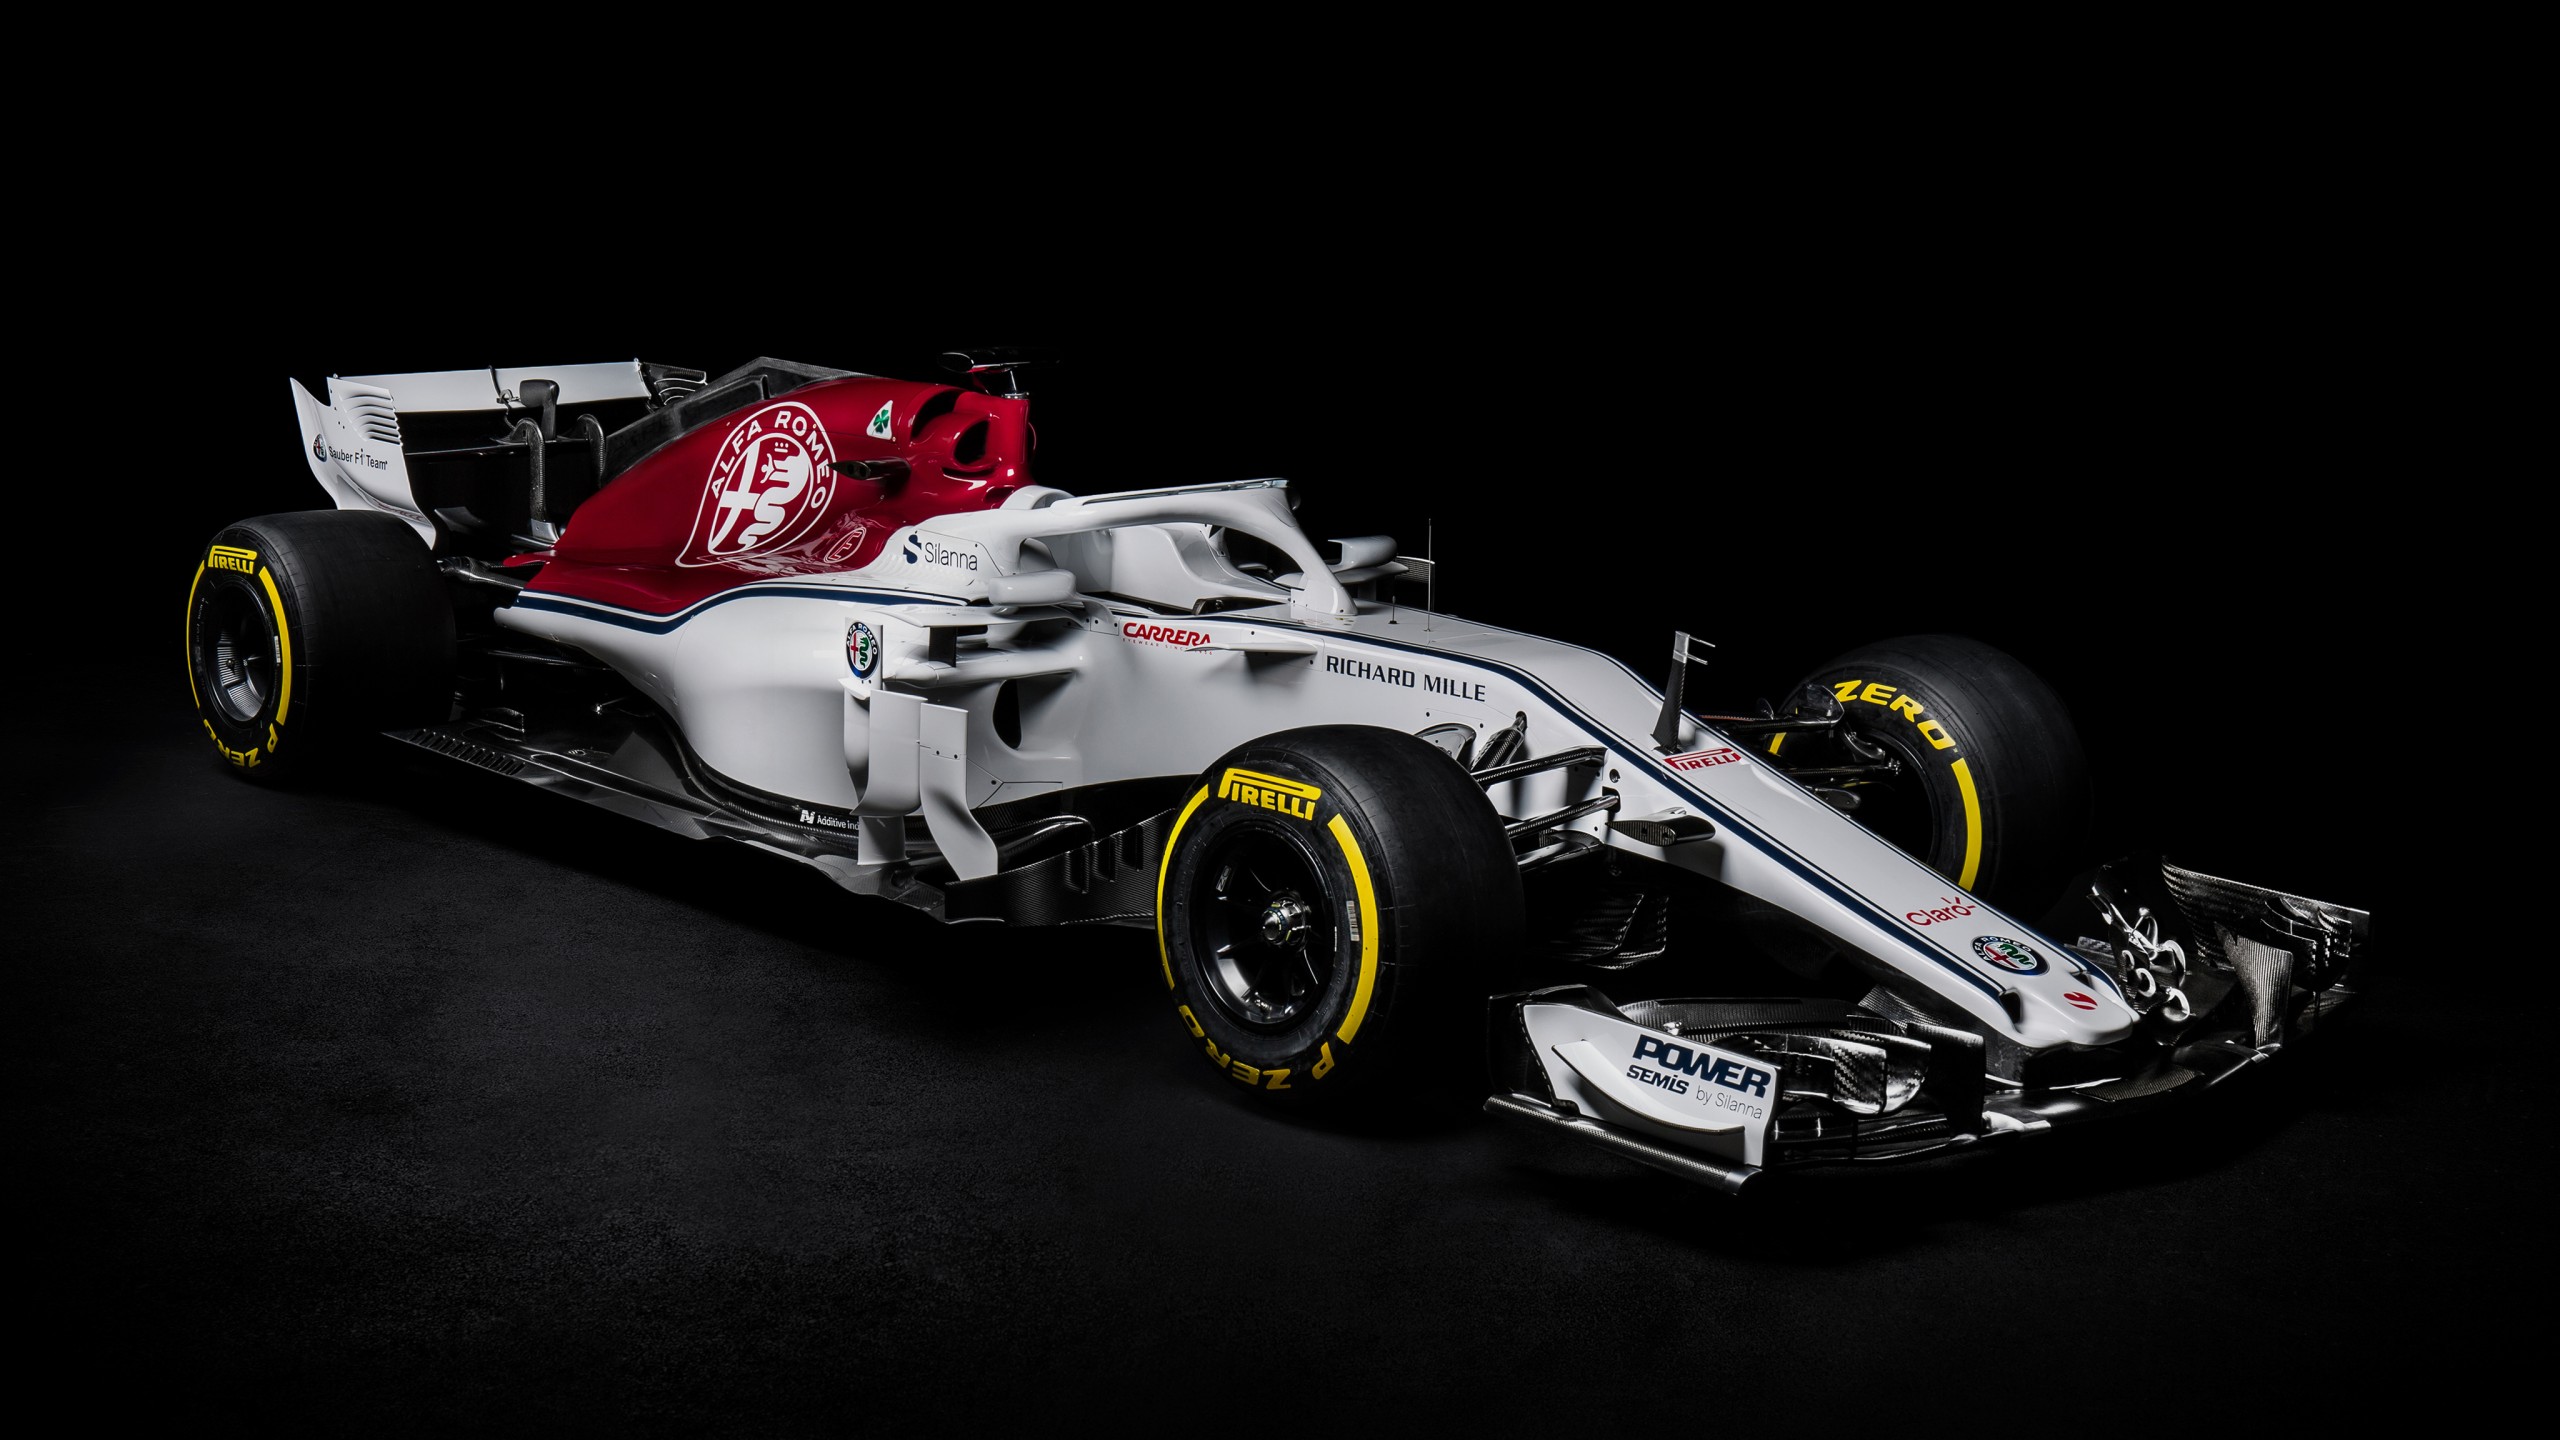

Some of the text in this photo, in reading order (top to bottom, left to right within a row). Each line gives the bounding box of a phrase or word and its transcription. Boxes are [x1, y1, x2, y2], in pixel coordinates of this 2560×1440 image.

[328, 446, 353, 462] Sauber
[711, 410, 830, 509] ALFA ROMEO
[207, 544, 258, 575] PIRELLI
[925, 541, 978, 571] Silanna
[858, 623, 878, 655] ROMEO
[1122, 622, 1211, 647] CARRERA
[1122, 637, 1159, 647] EYEWEAR
[1326, 655, 1486, 702] RICHARD MILLE
[1834, 679, 1957, 750] ZERO
[202, 718, 279, 768] P ZERO
[1662, 747, 1742, 771] PIRELLI
[1217, 767, 1322, 821] PIRELLI
[817, 815, 847, 829] Additive
[1906, 901, 1973, 926] Claro
[1981, 936, 2032, 952] ROMEO
[1177, 1004, 1335, 1090] P ZERO
[1632, 1034, 1771, 1098] POWER
[1696, 1085, 1713, 1106] by
[1715, 1092, 1763, 1119] Silanna
